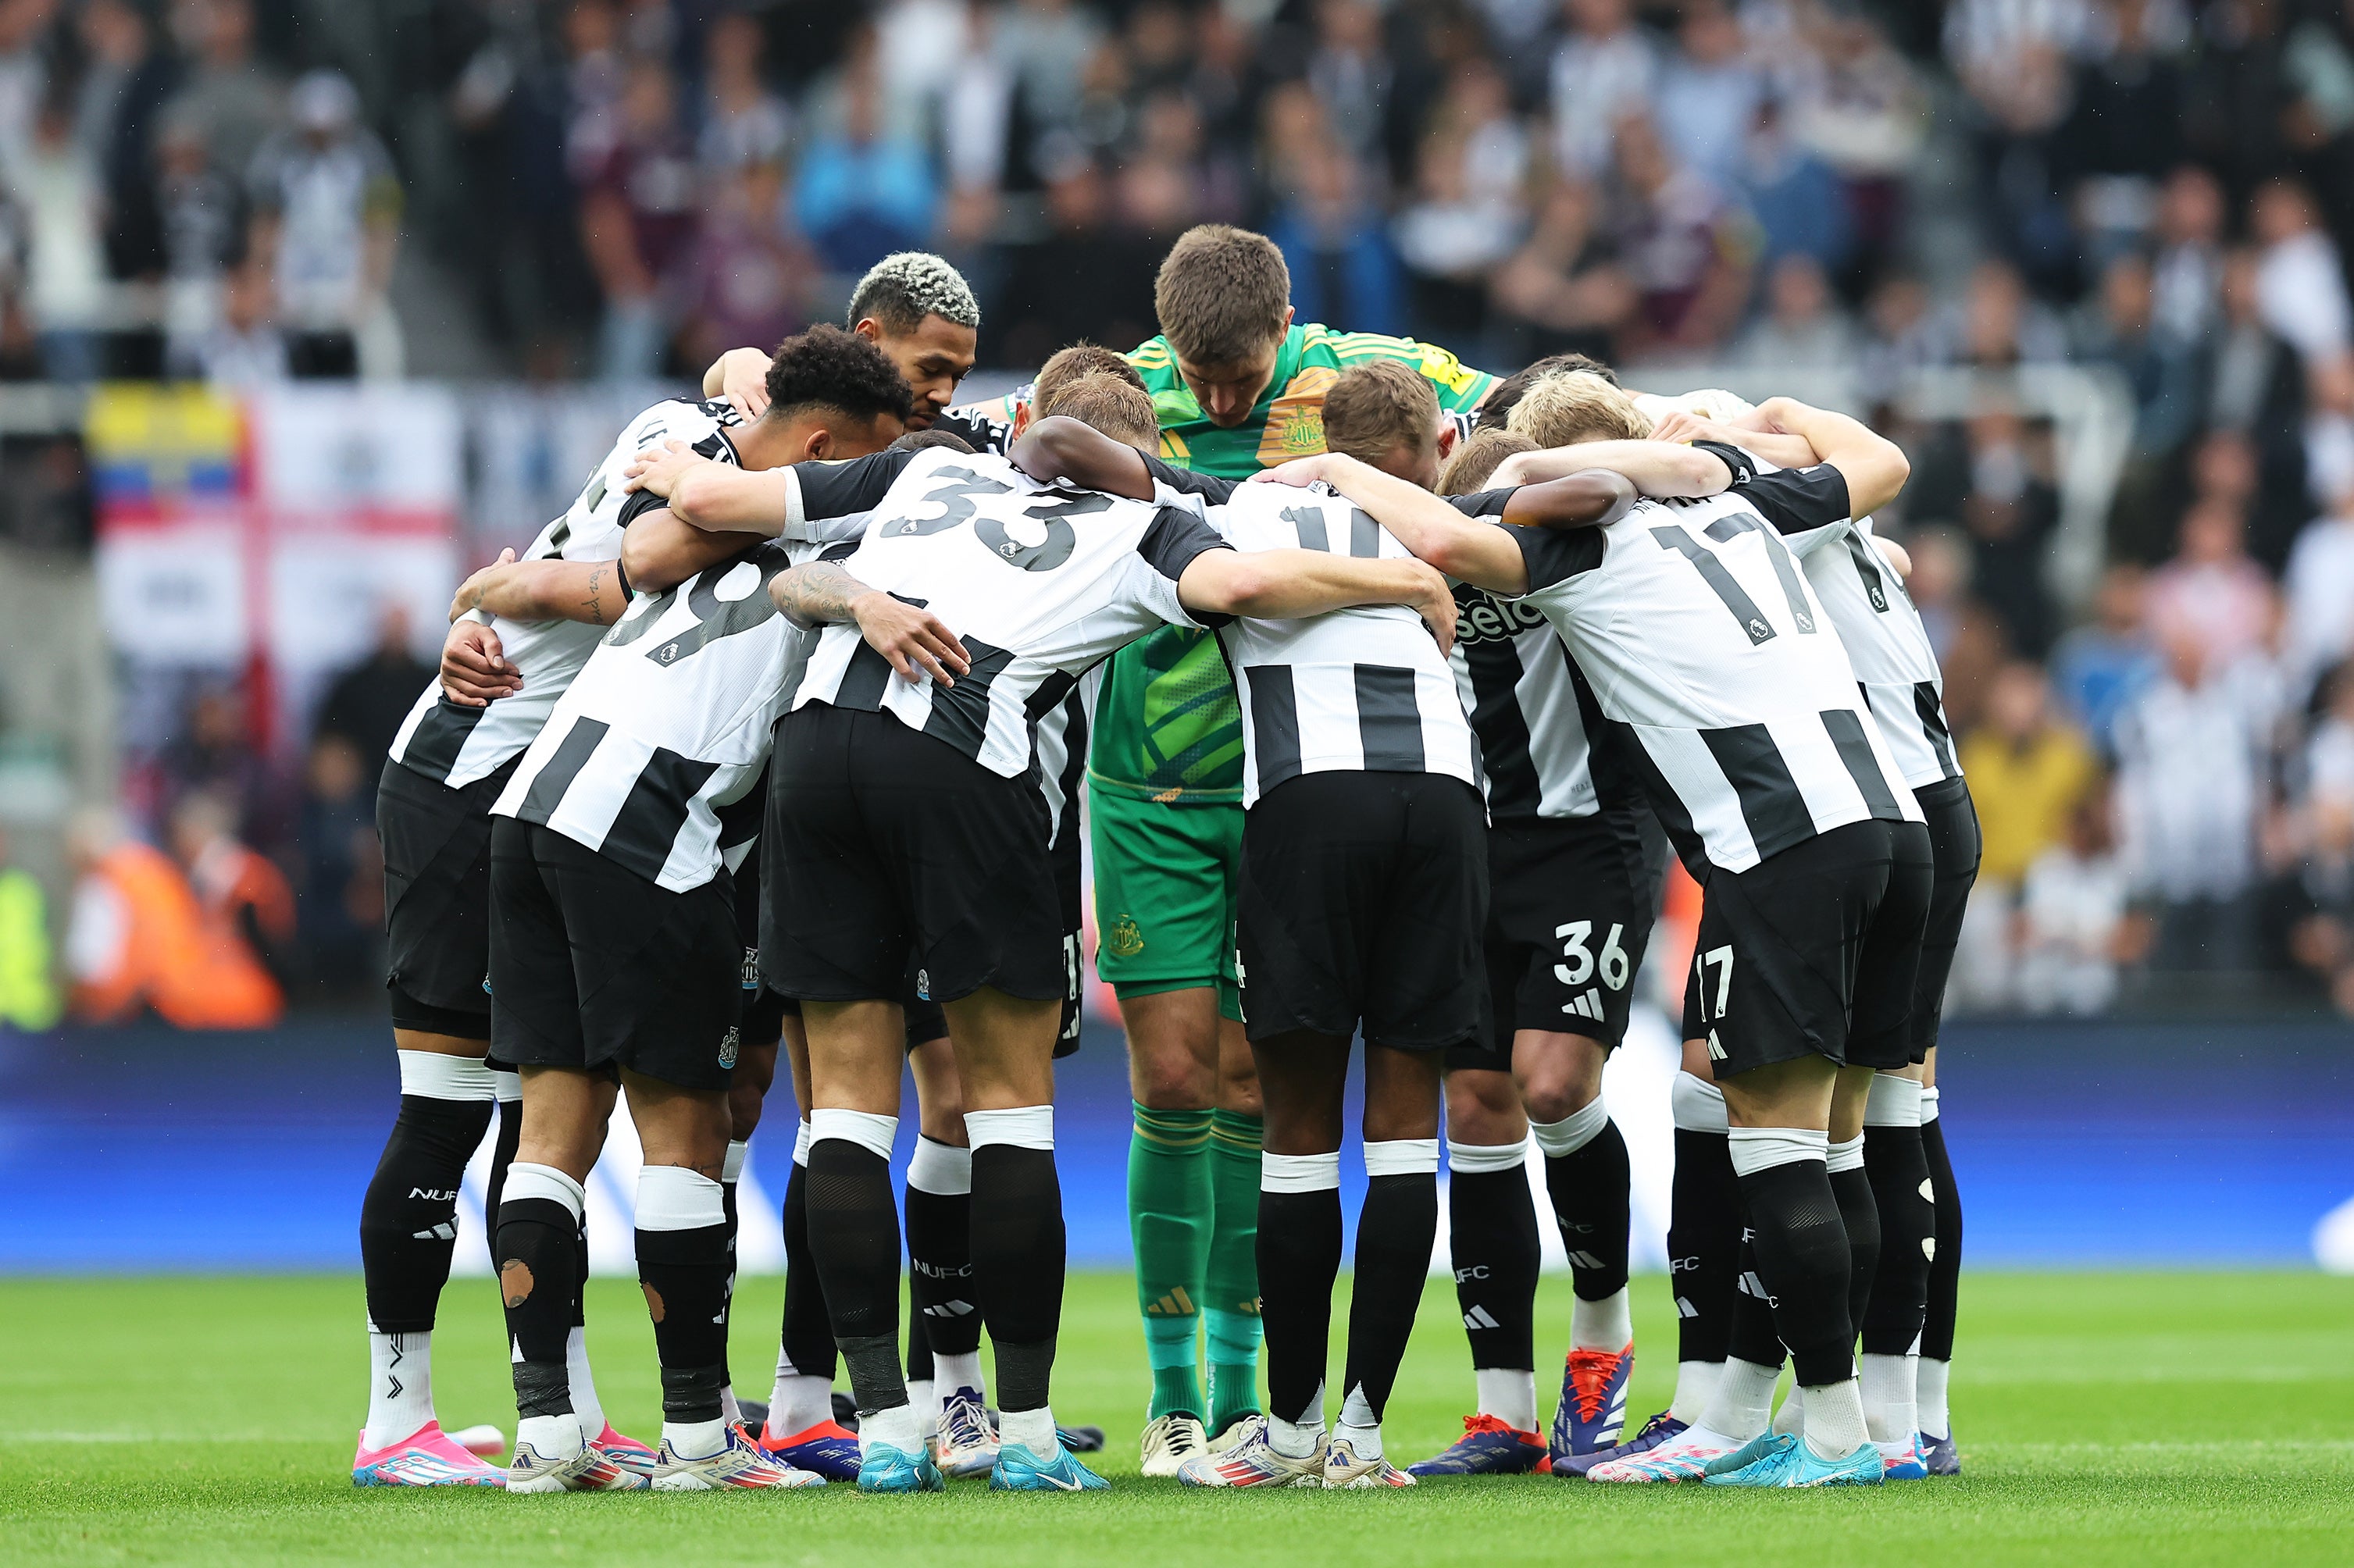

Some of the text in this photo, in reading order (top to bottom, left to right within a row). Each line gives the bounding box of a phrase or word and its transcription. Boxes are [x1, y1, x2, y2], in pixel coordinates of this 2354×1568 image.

[880, 465, 1115, 571] 33
[1648, 511, 1817, 647] 17
[1554, 920, 1629, 991] 36
[913, 1258, 972, 1279] NUFC
[377, 1455, 430, 1473] F50
[562, 1457, 595, 1477] F50
[704, 1459, 750, 1477] F50
[1248, 1454, 1289, 1475] F50
